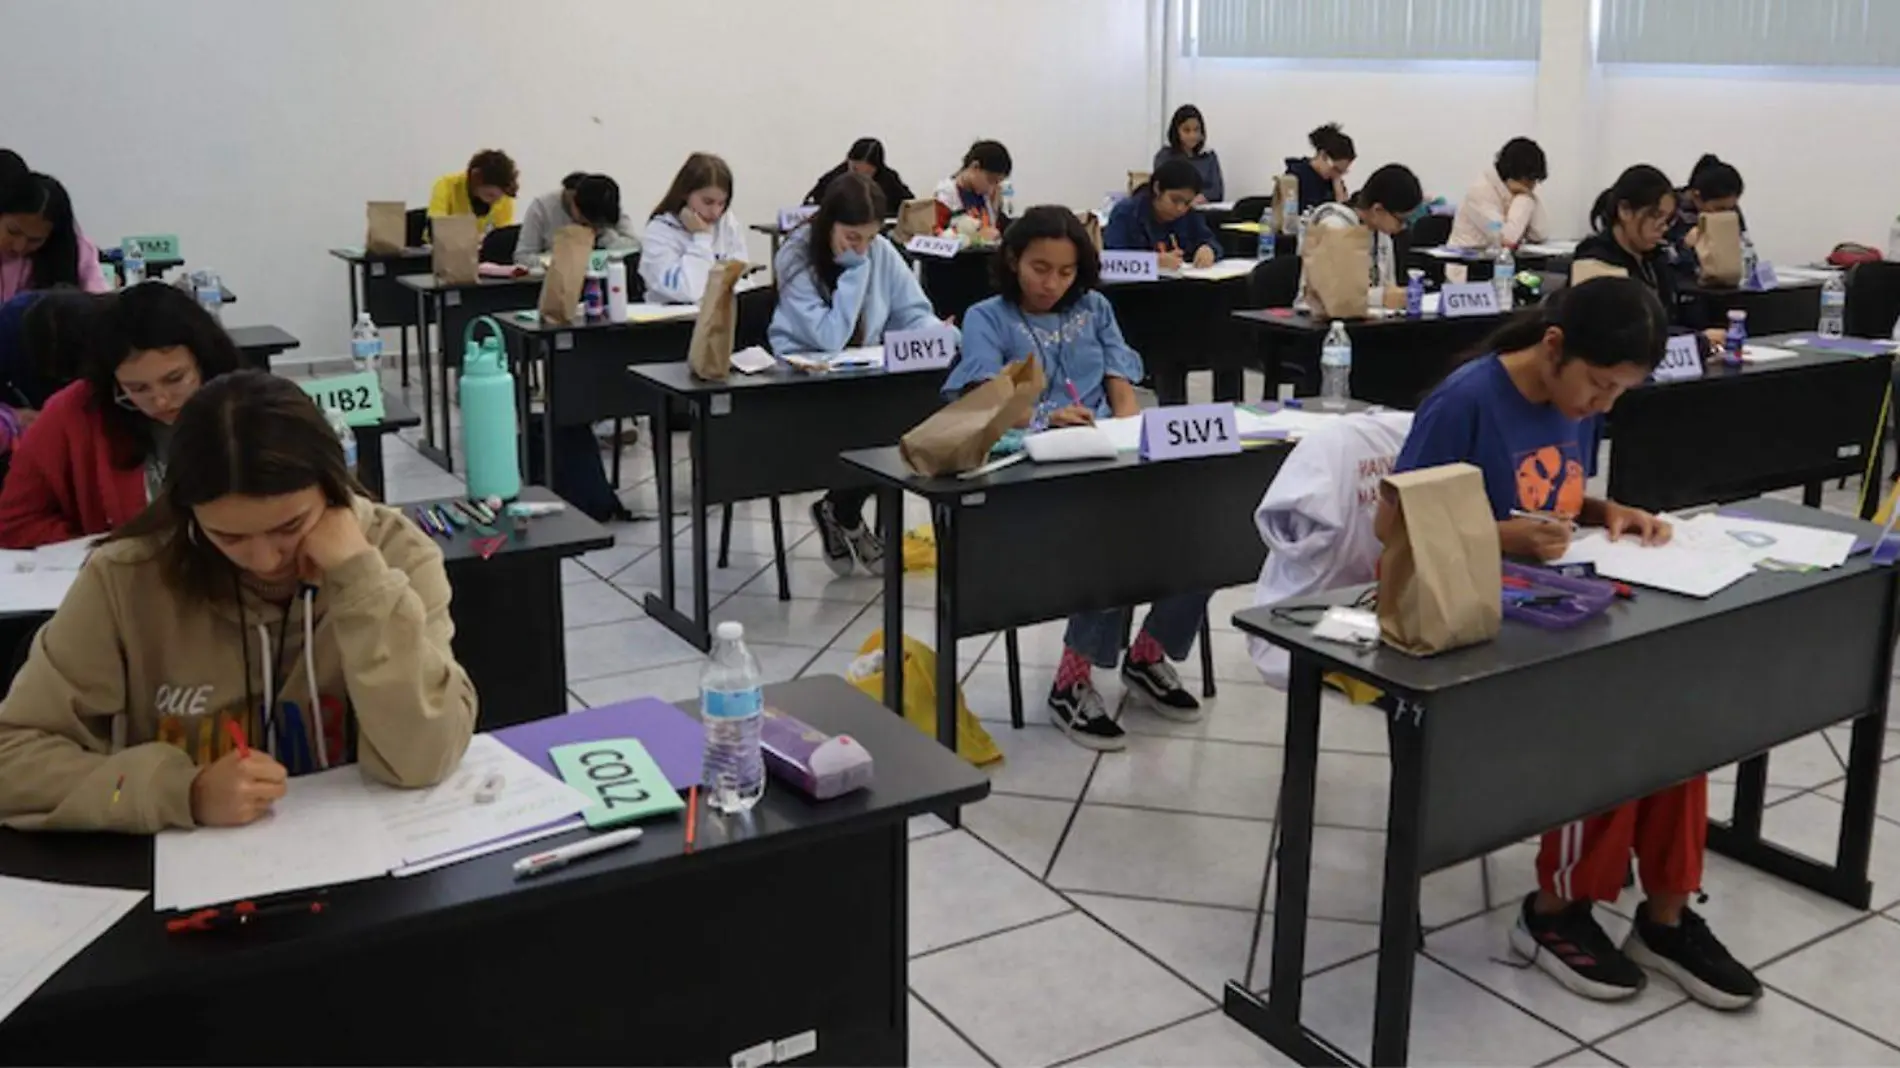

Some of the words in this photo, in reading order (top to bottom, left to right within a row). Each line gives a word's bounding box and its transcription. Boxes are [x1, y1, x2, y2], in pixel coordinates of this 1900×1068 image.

[1447, 292, 1492, 309] GTM1
[893, 337, 948, 362] URY1
[1659, 347, 1695, 369] CU1
[1166, 416, 1229, 447] SLV1
[154, 684, 214, 717] QUE
[579, 748, 651, 810] COL2
